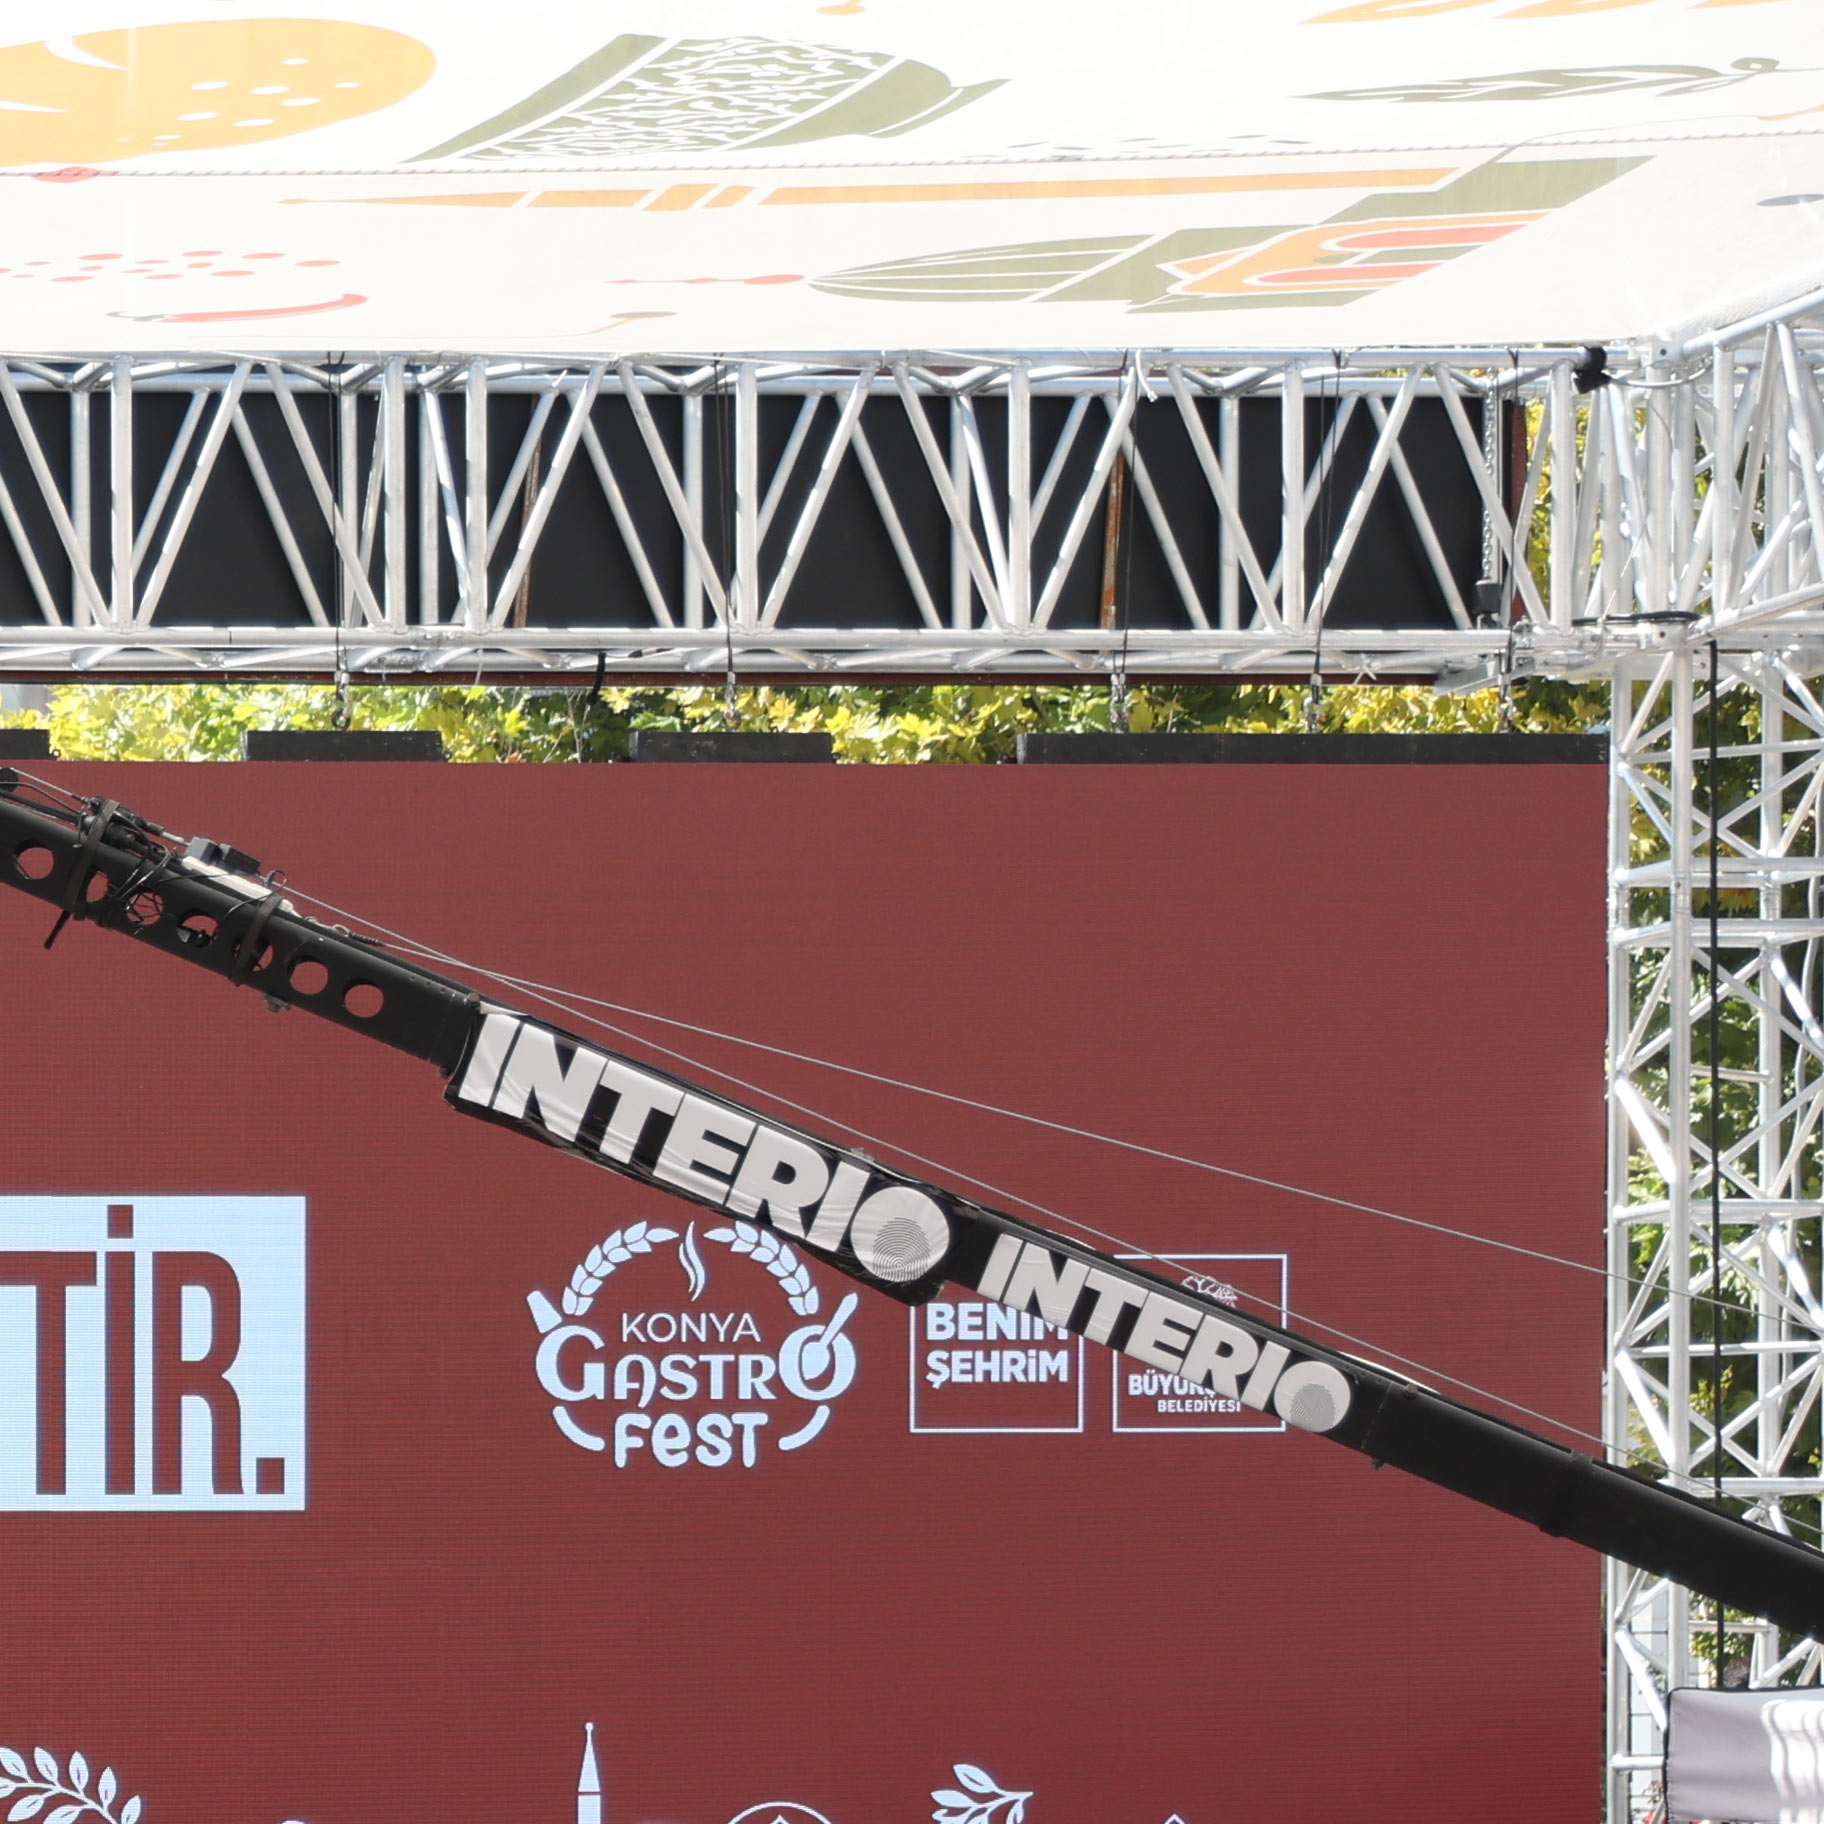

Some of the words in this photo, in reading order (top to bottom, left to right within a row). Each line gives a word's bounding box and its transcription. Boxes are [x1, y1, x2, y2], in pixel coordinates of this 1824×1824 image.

[458, 1013, 951, 1284] INTERIO
[535, 1325, 856, 1408] GASTRO
[621, 1312, 762, 1343] KONYA
[977, 1232, 1351, 1433] INTERIO
